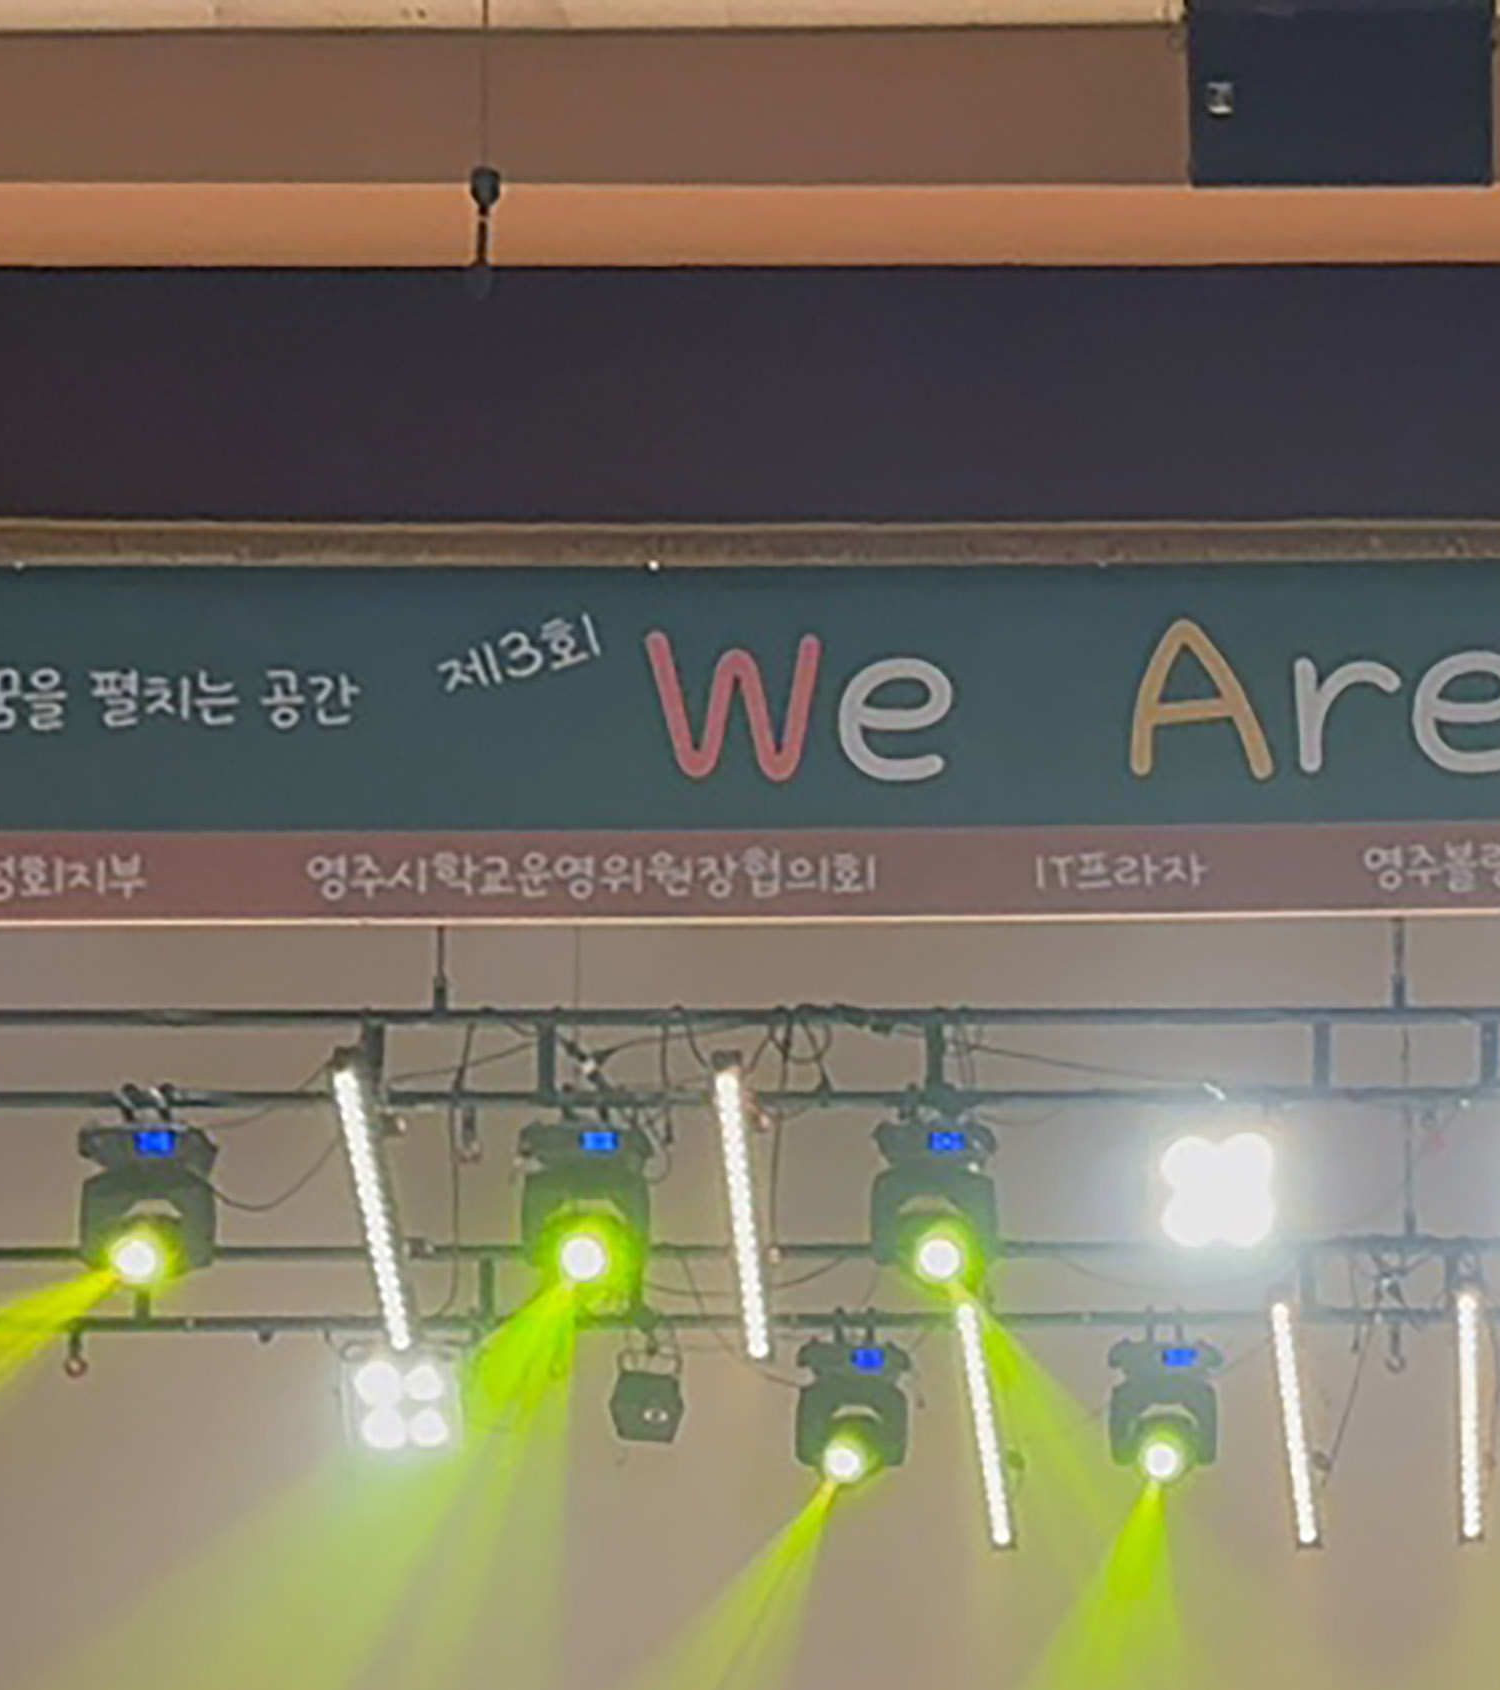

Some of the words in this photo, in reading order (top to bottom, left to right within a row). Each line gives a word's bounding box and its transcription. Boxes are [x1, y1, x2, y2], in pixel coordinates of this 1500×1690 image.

[437, 612, 601, 692] 제3회
[89, 668, 240, 728] 펼치는
[260, 668, 361, 728] 공간
[644, 630, 955, 783] We
[306, 847, 877, 900] 영주시학교운영위원장협의회
[1035, 851, 1206, 890] IT프라자
